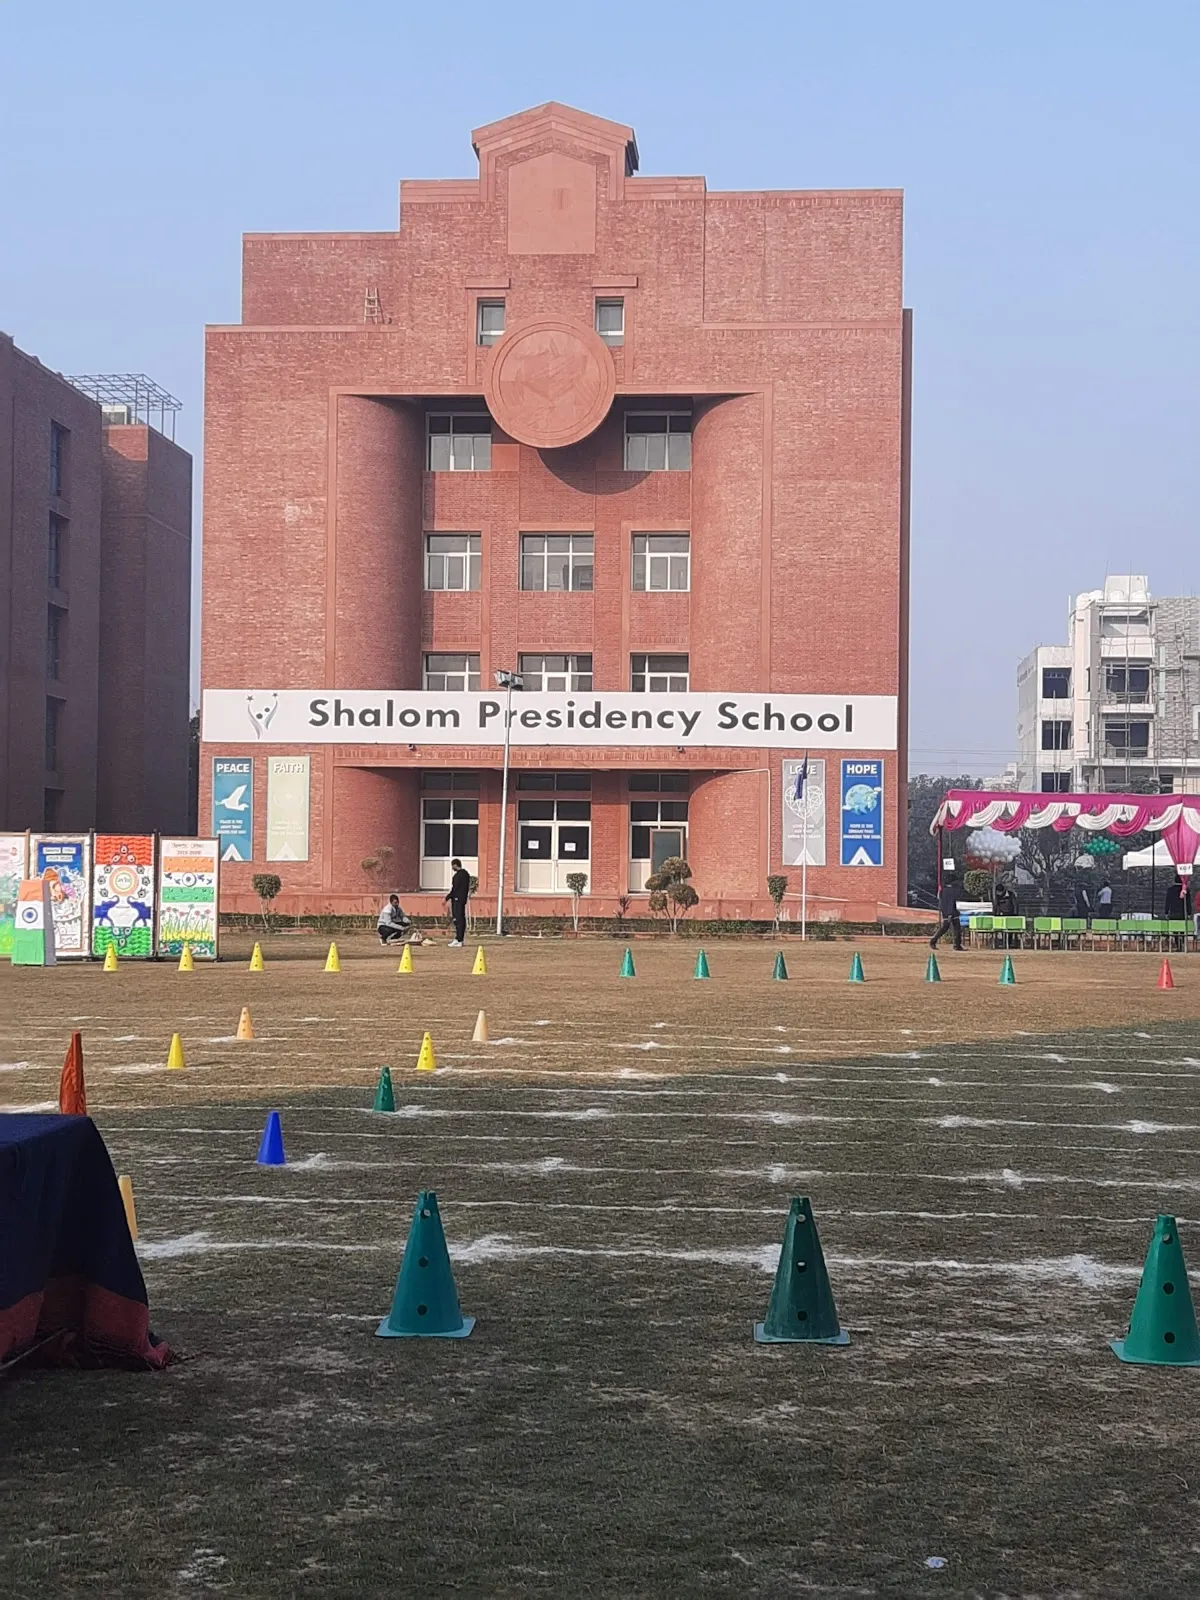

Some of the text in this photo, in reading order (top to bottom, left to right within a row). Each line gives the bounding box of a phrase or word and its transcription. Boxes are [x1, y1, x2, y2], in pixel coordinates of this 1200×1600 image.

[308, 699, 853, 737] Shalom Presidency School
[216, 763, 250, 773] PEACE
[273, 763, 304, 774] FAITH
[846, 764, 878, 775] HOPE
